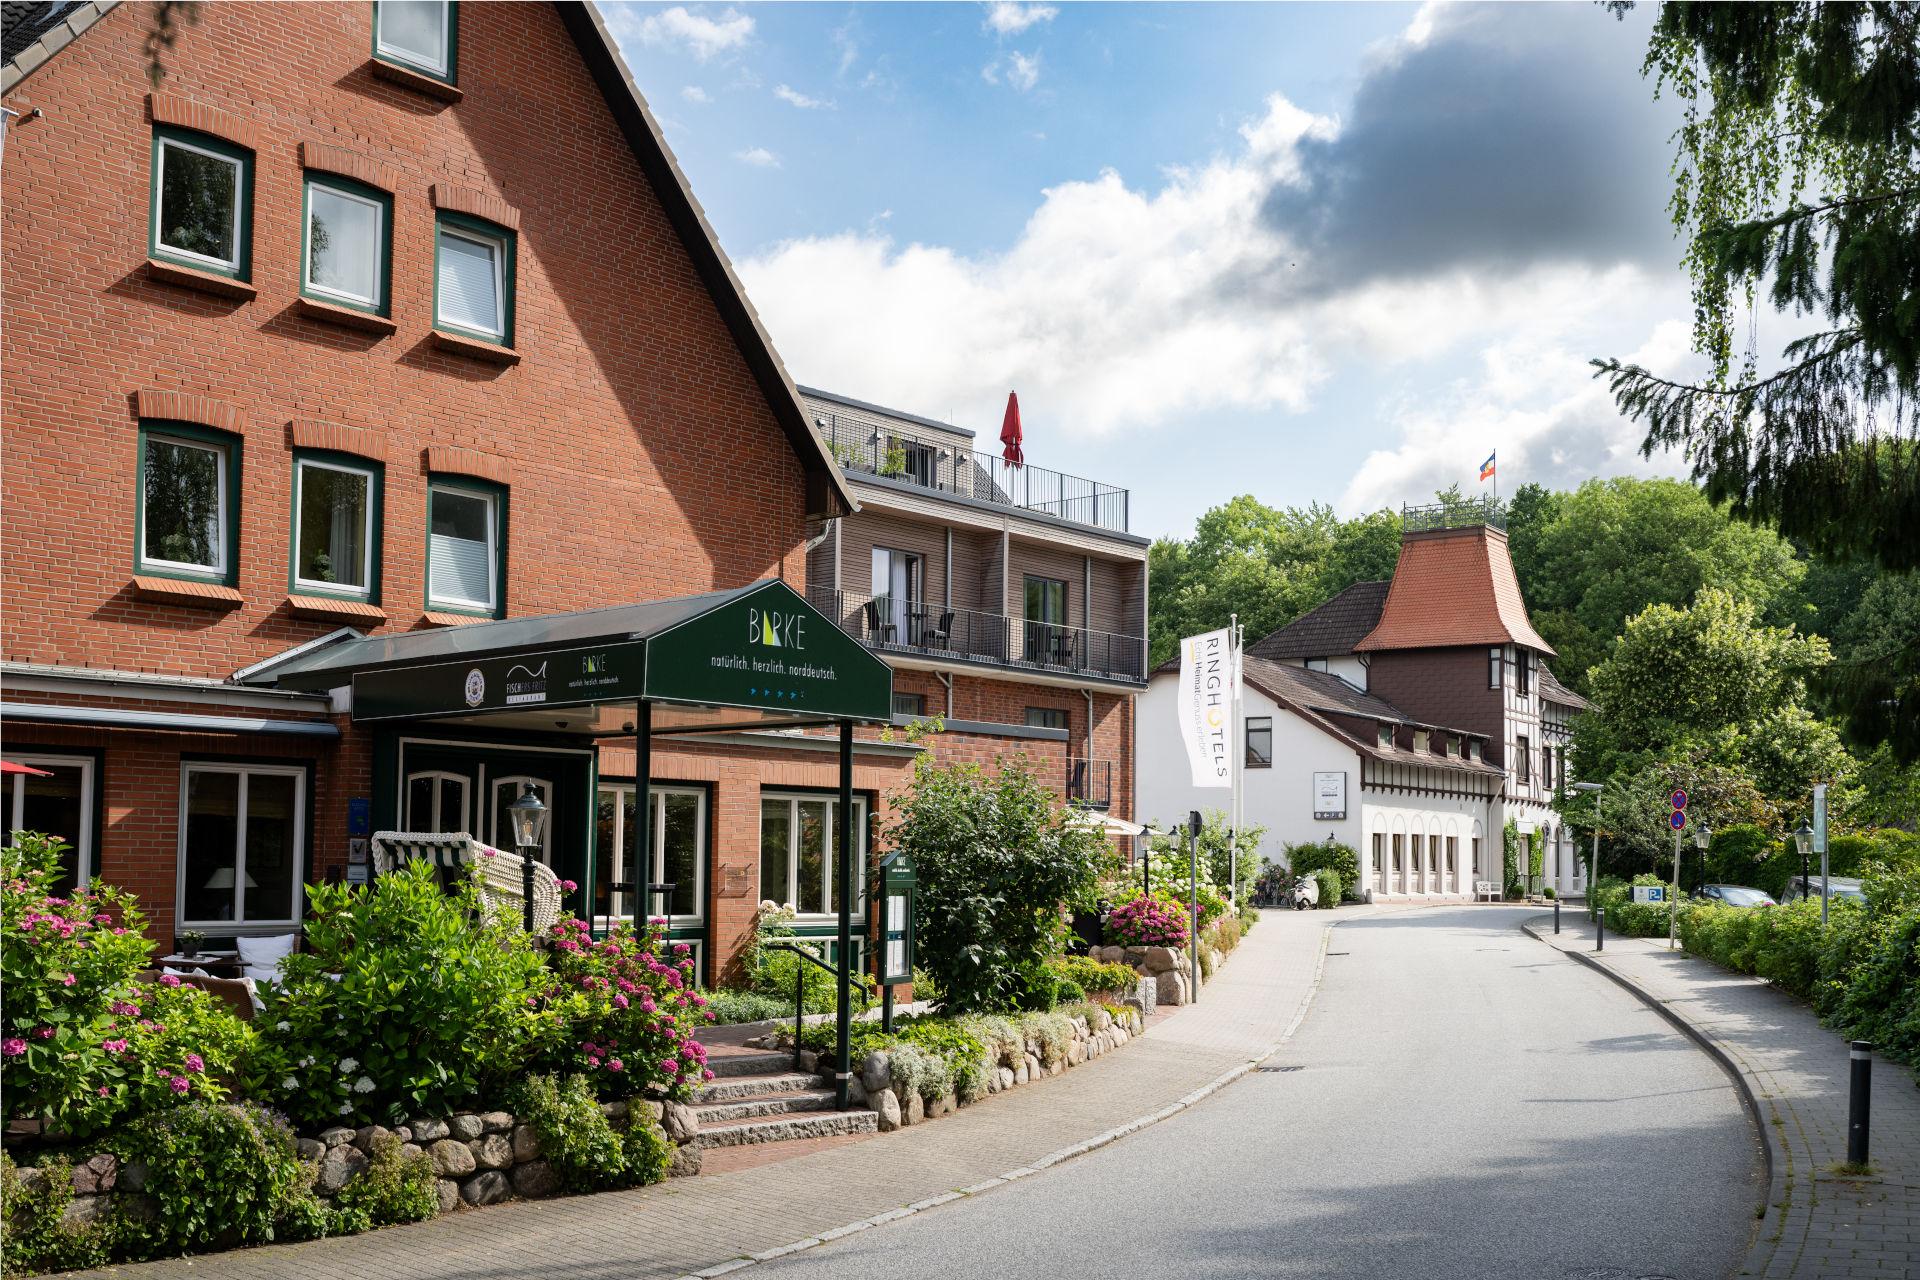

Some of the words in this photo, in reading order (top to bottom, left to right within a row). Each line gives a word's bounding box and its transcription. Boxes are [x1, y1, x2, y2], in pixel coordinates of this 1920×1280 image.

[711, 654, 750, 671] natürlich.
[752, 656, 786, 674] herzlich.
[789, 663, 838, 681] norddeutsch.
[506, 682, 532, 694] FISCHERS
[532, 680, 547, 691] FRITZ
[1206, 637, 1227, 777] RINGHOTELS
